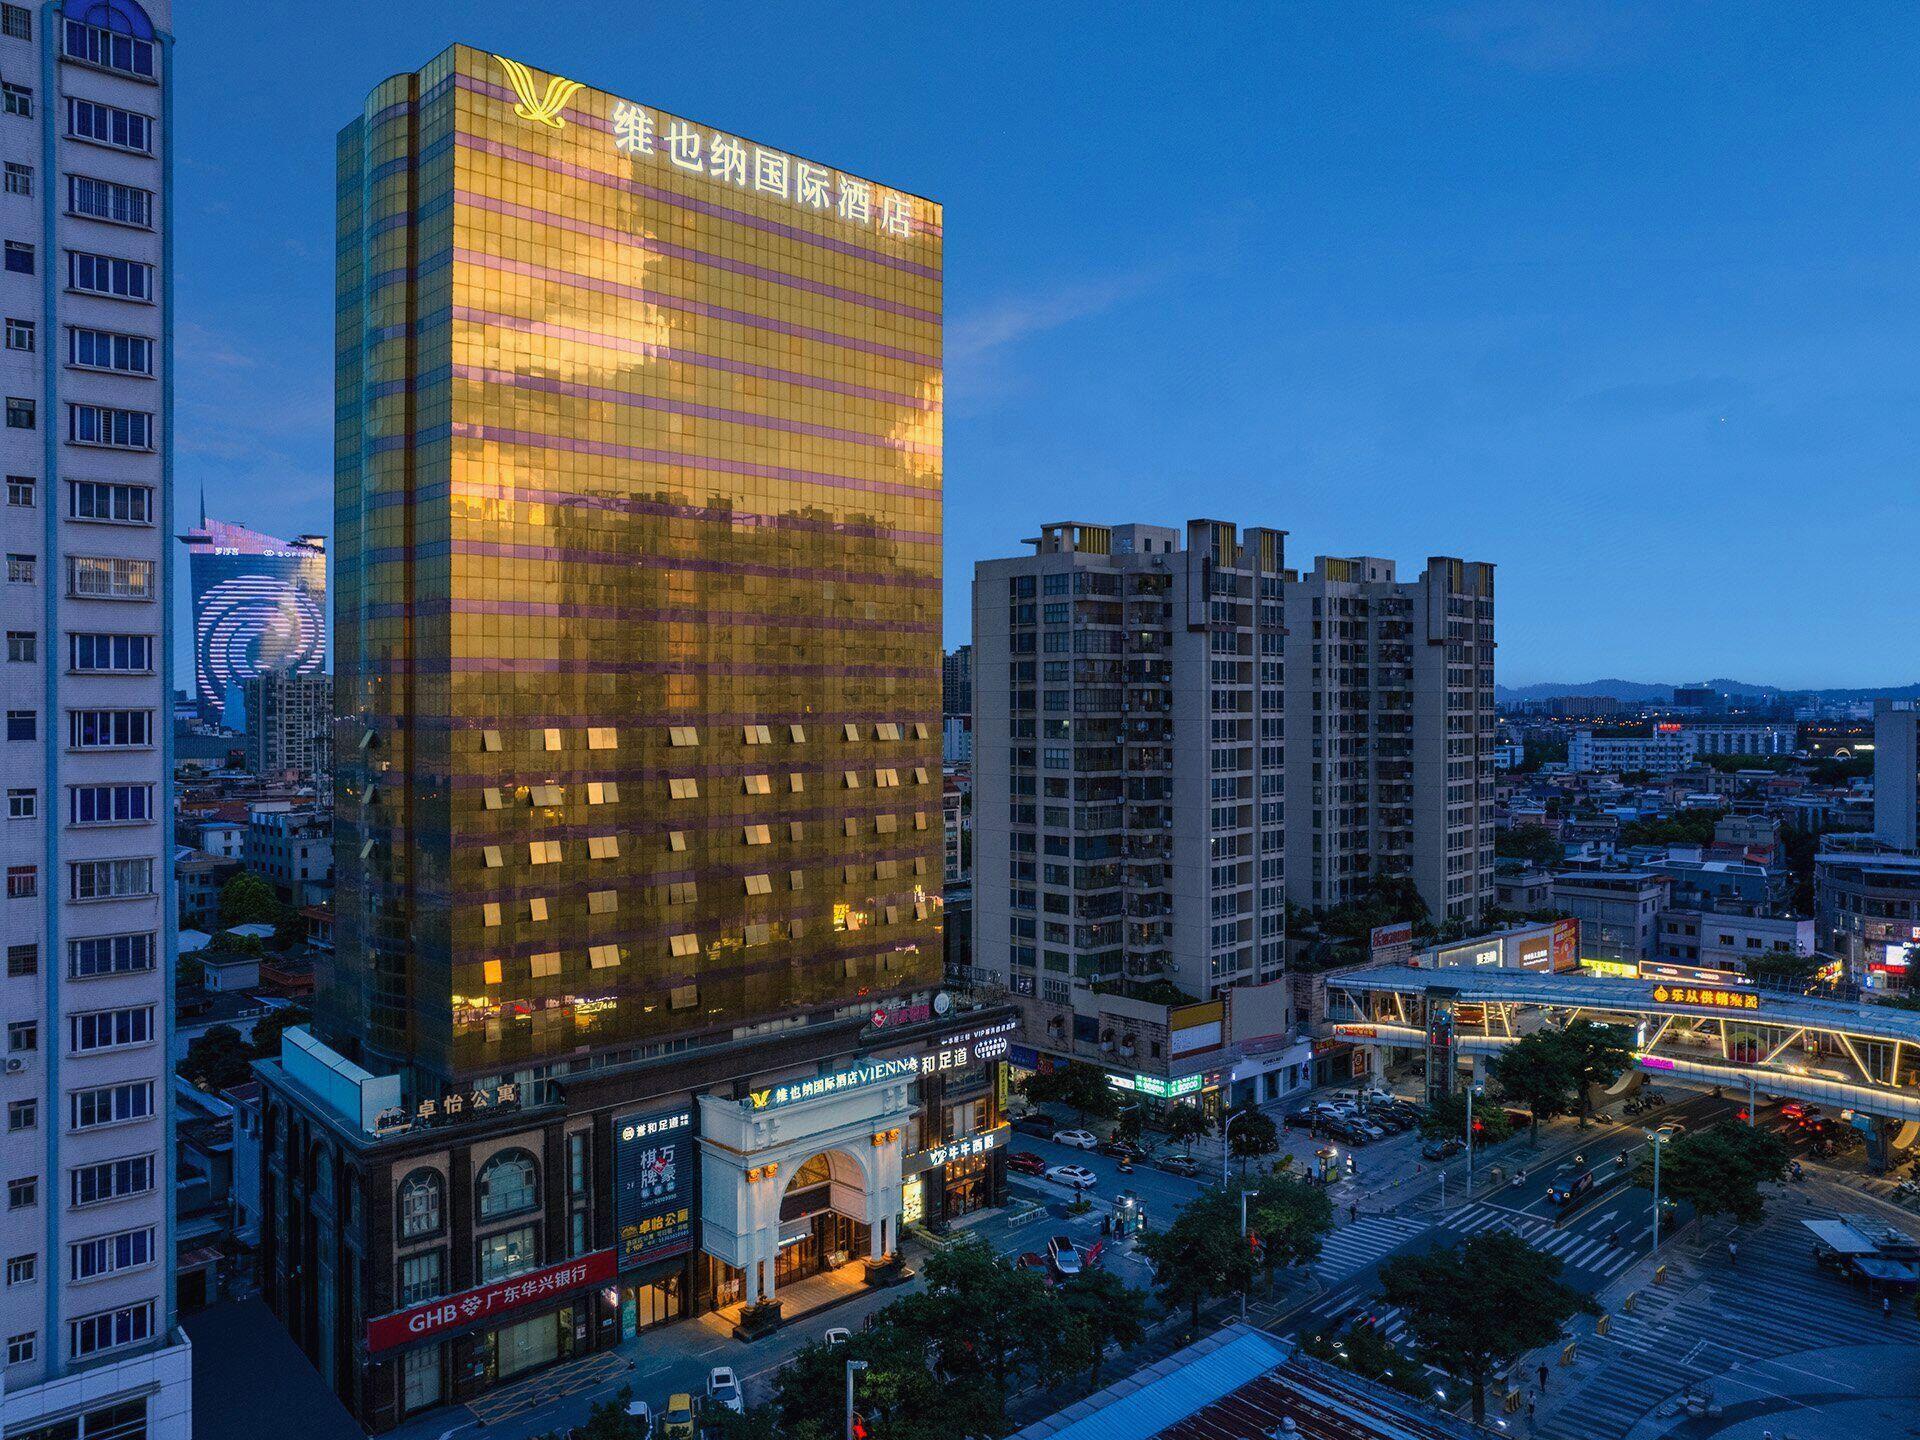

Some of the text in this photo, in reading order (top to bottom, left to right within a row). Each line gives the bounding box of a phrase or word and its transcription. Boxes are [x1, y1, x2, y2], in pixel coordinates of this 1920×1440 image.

[612, 100, 912, 238] 维也纳国际酒店
[417, 1083, 515, 1119] 卓怡公寓
[776, 1069, 858, 1103] 维也纳国际酒店
[408, 1264, 588, 1333] GHB 广东华兴银行
